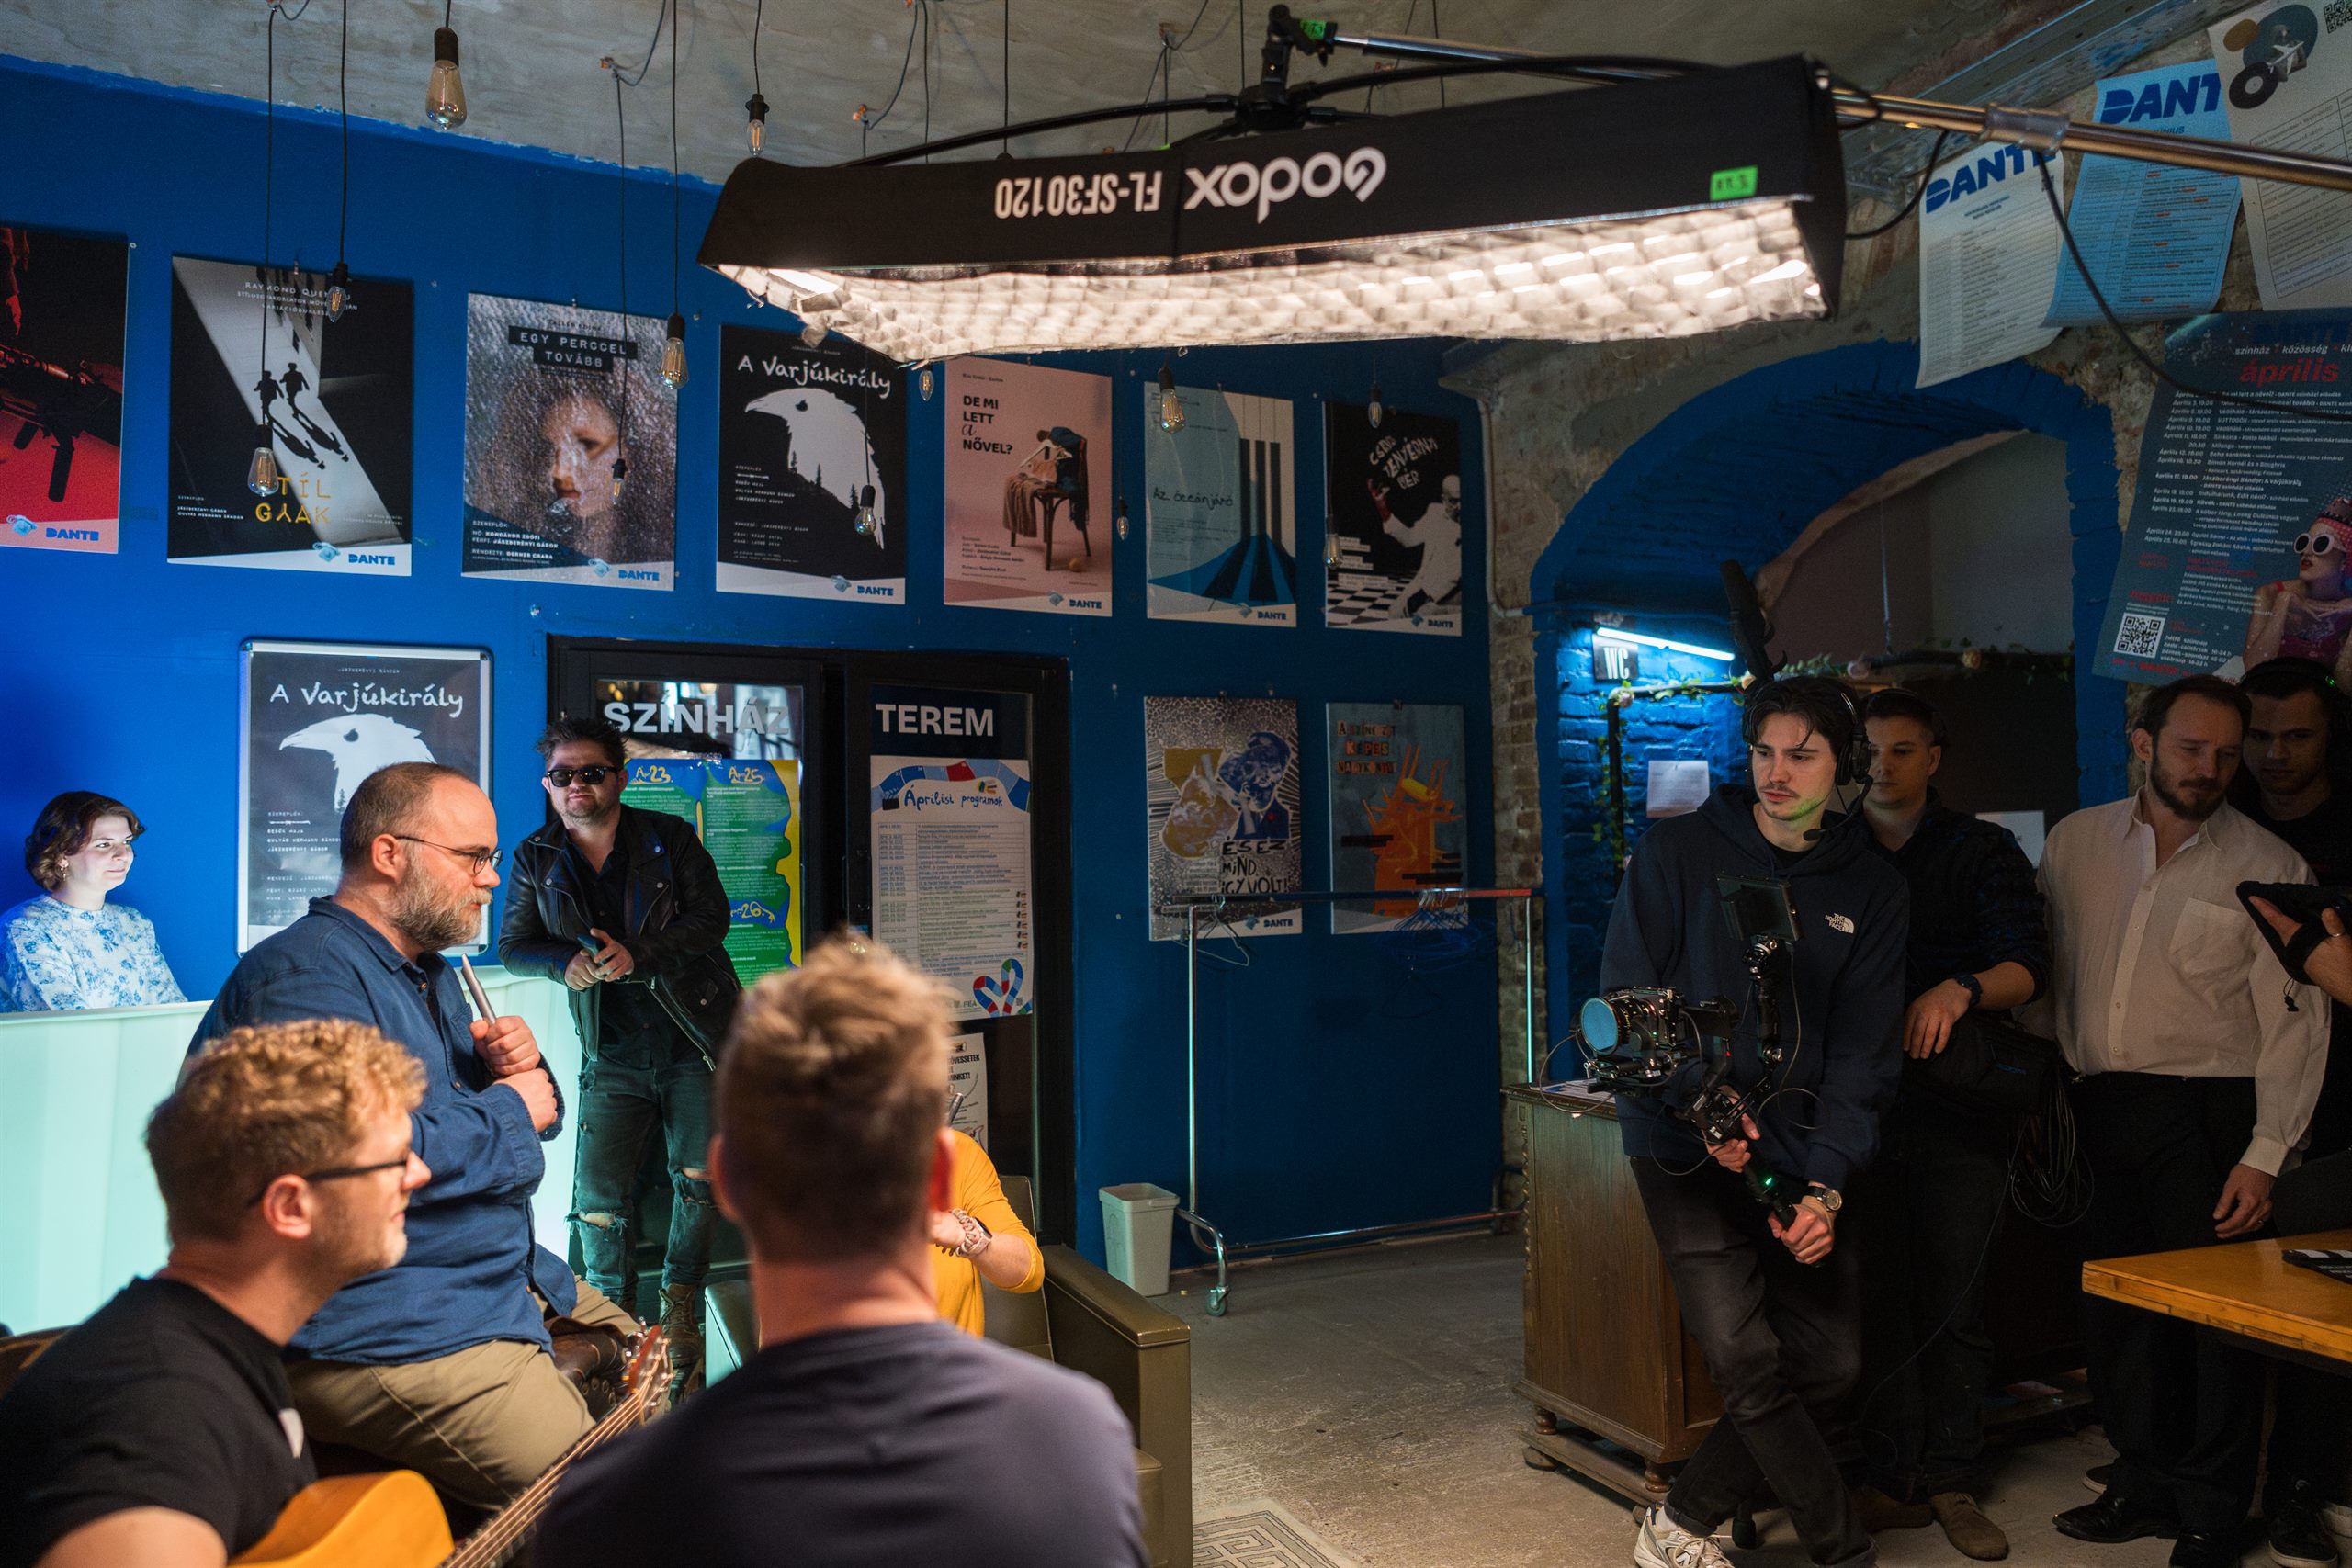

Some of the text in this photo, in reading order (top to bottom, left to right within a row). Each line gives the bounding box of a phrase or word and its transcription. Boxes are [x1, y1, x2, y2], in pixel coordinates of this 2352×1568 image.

[2100, 73, 2222, 124] DANT
[1184, 147, 1386, 224] Godox
[994, 171, 1162, 219] FL-SF30120
[520, 333, 627, 355] EGY PERCCEL
[2234, 345, 2271, 355] színház
[2282, 344, 2328, 355] közösség
[545, 351, 603, 367] TOVÁBB
[737, 355, 891, 400] A Varjúkirály
[2240, 357, 2338, 388] április
[963, 395, 999, 410] DE MI
[963, 411, 995, 424] LETT
[962, 424, 977, 436] a
[963, 437, 1013, 455] NŐVEL?
[277, 472, 331, 499] TÍL
[46, 527, 99, 542] DANTE
[349, 554, 395, 566] DANTE
[619, 570, 660, 581] DANTE
[857, 586, 894, 597] DANTE
[1069, 599, 1102, 610] DANTE
[1257, 610, 1287, 621] DANTE
[1428, 619, 1454, 629] DANTE
[1604, 647, 1630, 680] WC
[269, 682, 463, 718] A Varjúkirály
[605, 696, 789, 735] SZÍNHÁZ
[876, 704, 993, 737] TEREM
[904, 784, 1004, 811] Áprilisi programok
[1222, 836, 1286, 855] ÉS EZ
[1248, 876, 1288, 893] VOLT!
[1264, 919, 1294, 927] DANTE
